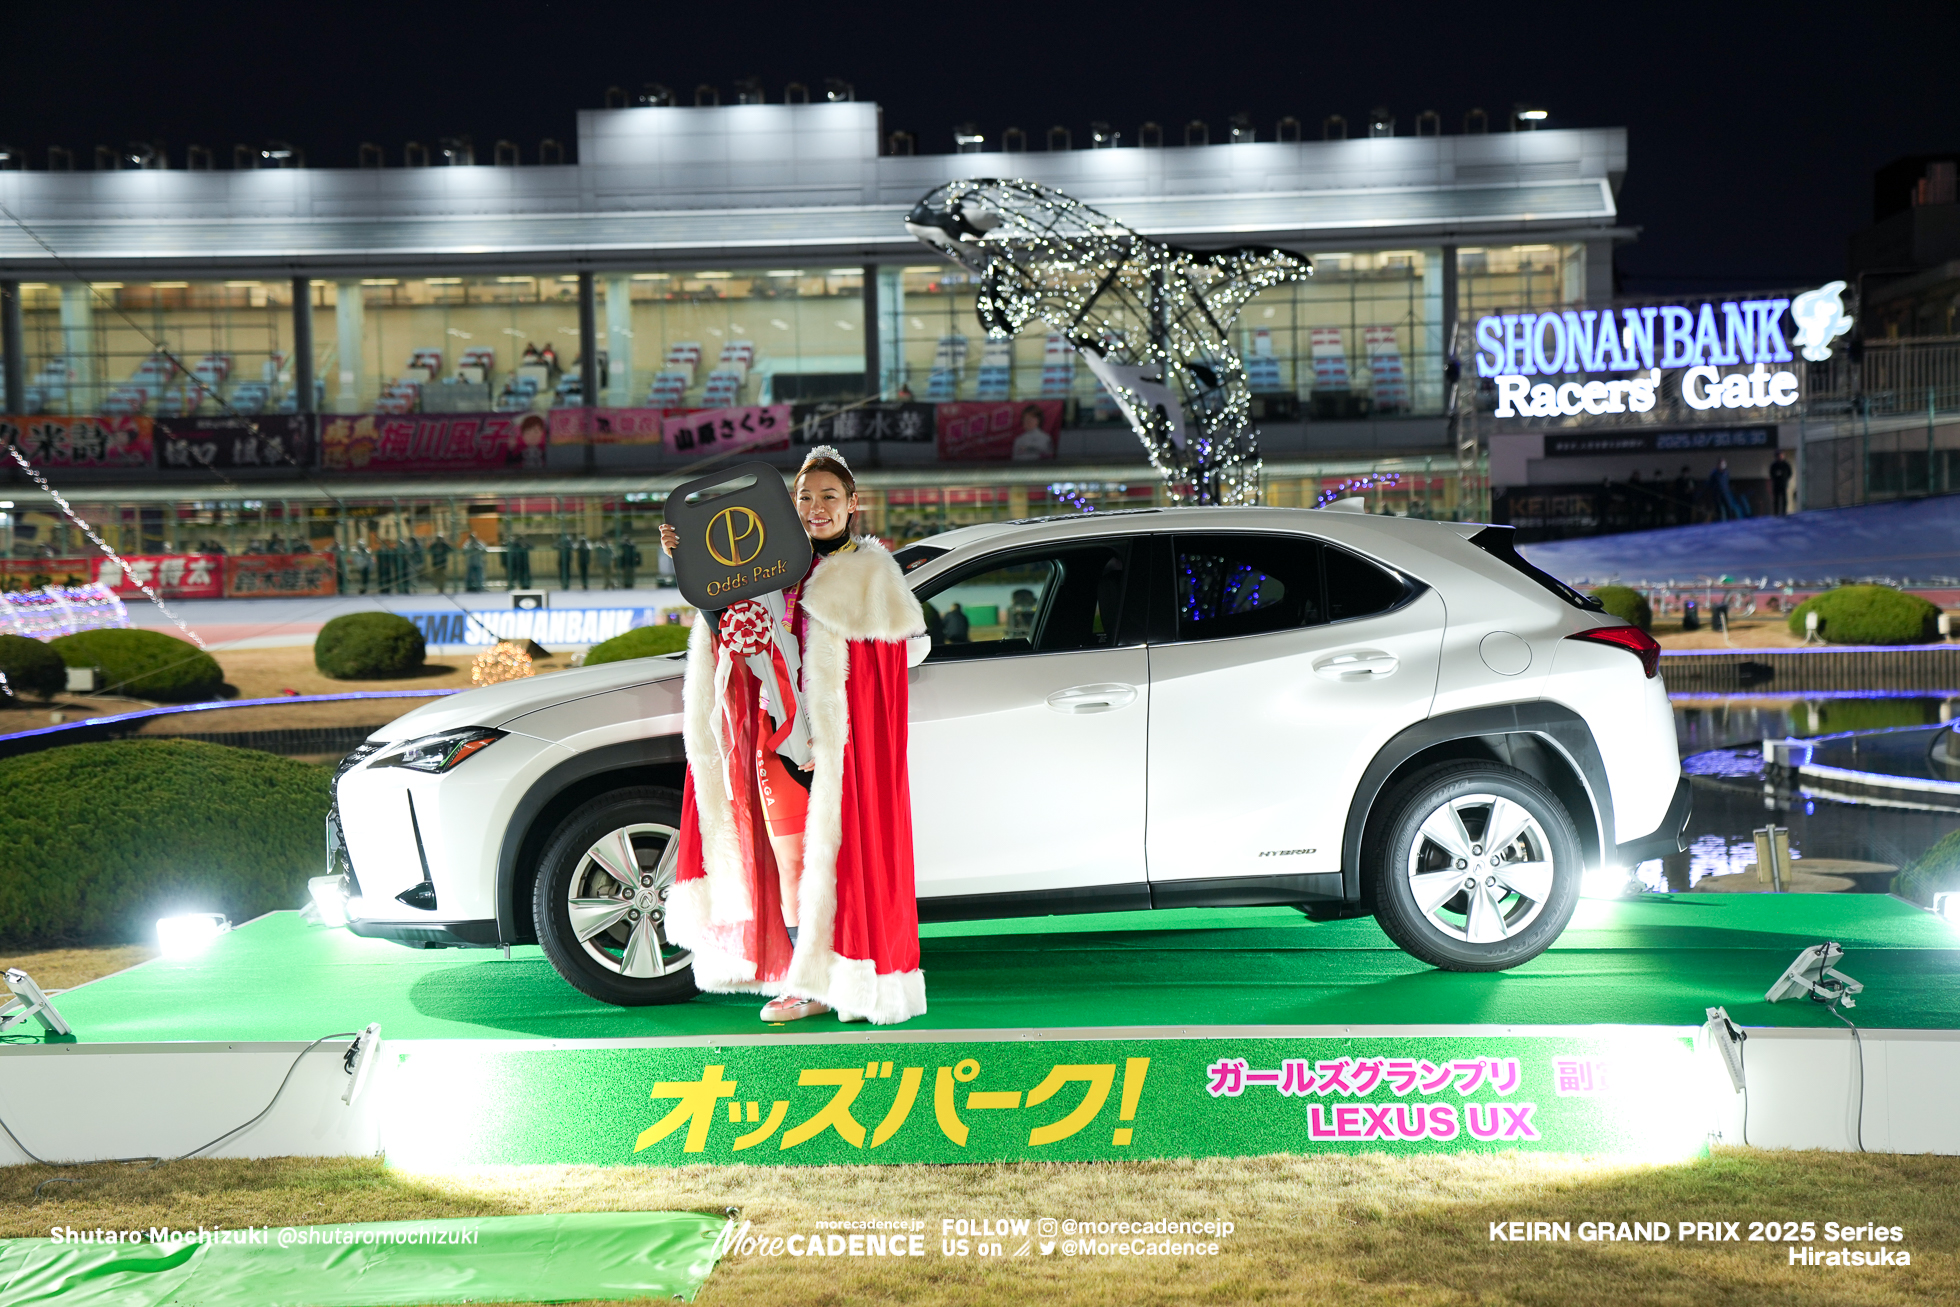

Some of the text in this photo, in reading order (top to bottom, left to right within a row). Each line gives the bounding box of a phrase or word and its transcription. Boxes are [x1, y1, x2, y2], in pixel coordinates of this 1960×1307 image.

[1494, 362, 1799, 418] Racers' Gate
[707, 559, 788, 596] Odds Park
[1258, 848, 1317, 857] HYBRID
[1209, 1060, 1517, 1094] ガールズグランプリ
[1311, 1107, 1534, 1137] LEXUS UX
